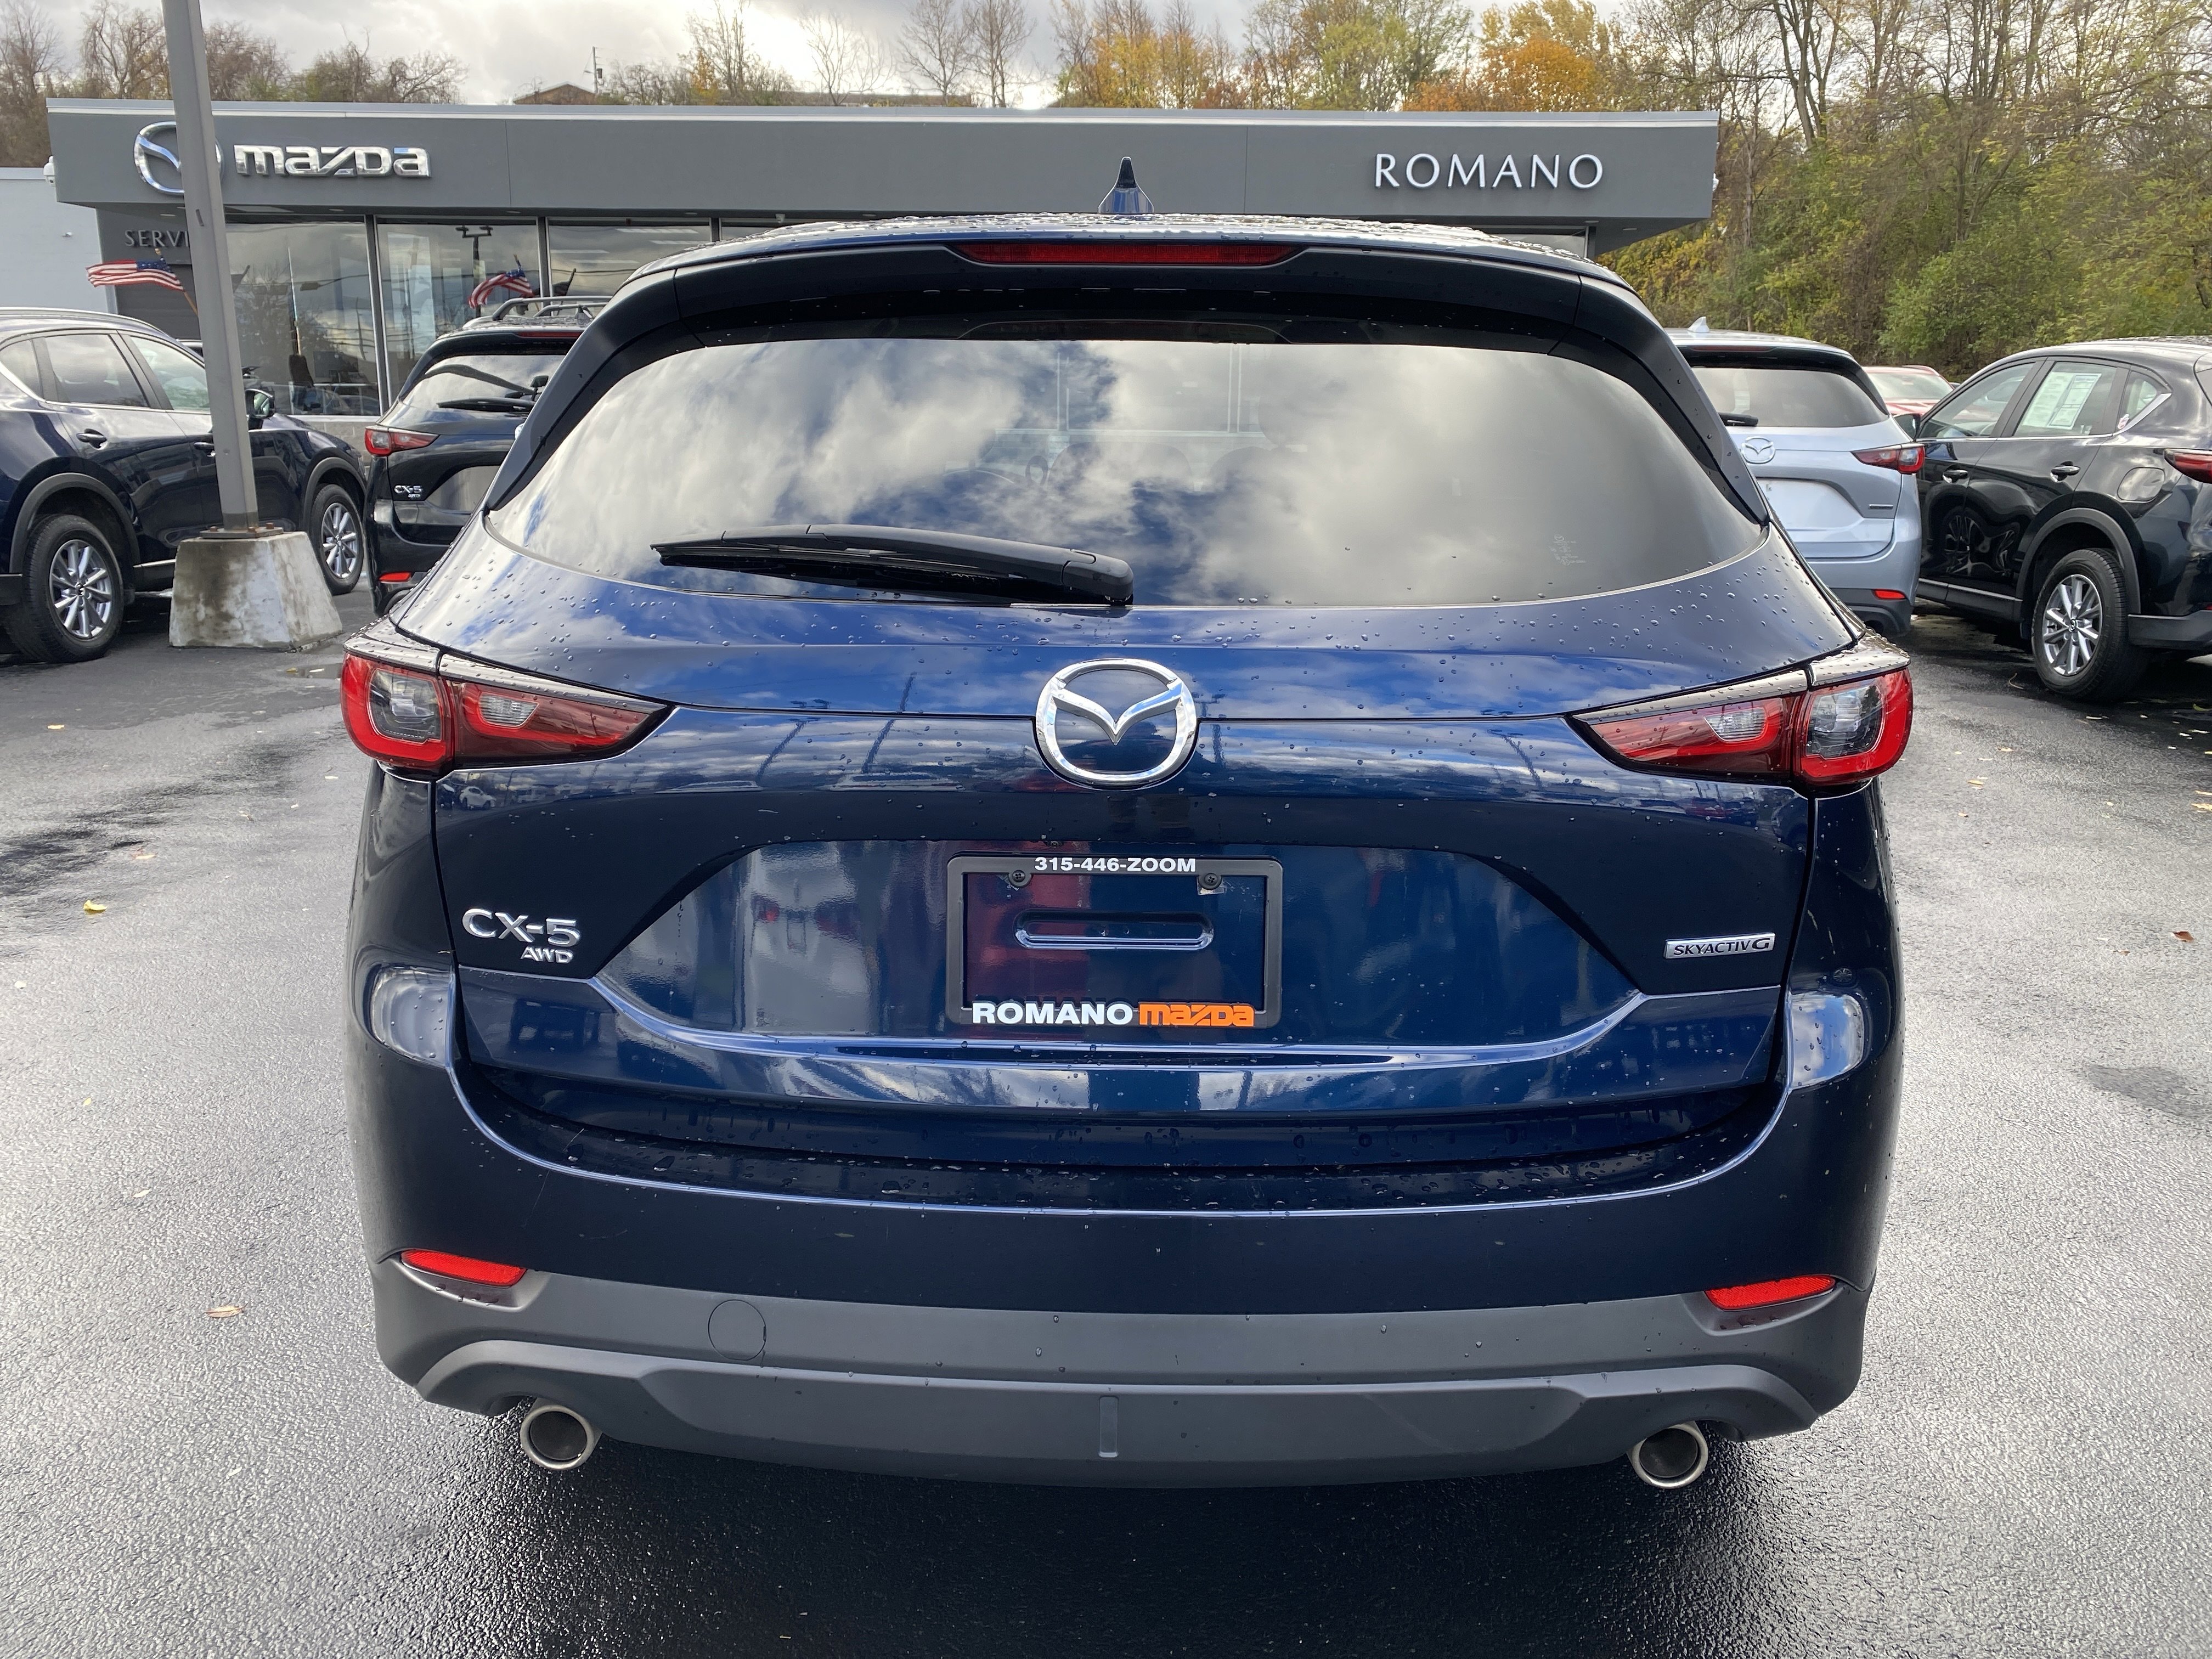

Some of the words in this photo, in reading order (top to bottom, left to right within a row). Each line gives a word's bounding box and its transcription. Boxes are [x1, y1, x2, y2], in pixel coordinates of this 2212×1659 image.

[1375, 153, 1603, 189] ROMANO
[124, 229, 189, 247] SERVI
[394, 485, 422, 494] CX-5
[1034, 857, 1196, 872] 315-446-ZOOM
[462, 908, 580, 947] CX-5
[521, 946, 574, 964] AWD
[972, 1002, 1133, 1025] ROMANO
